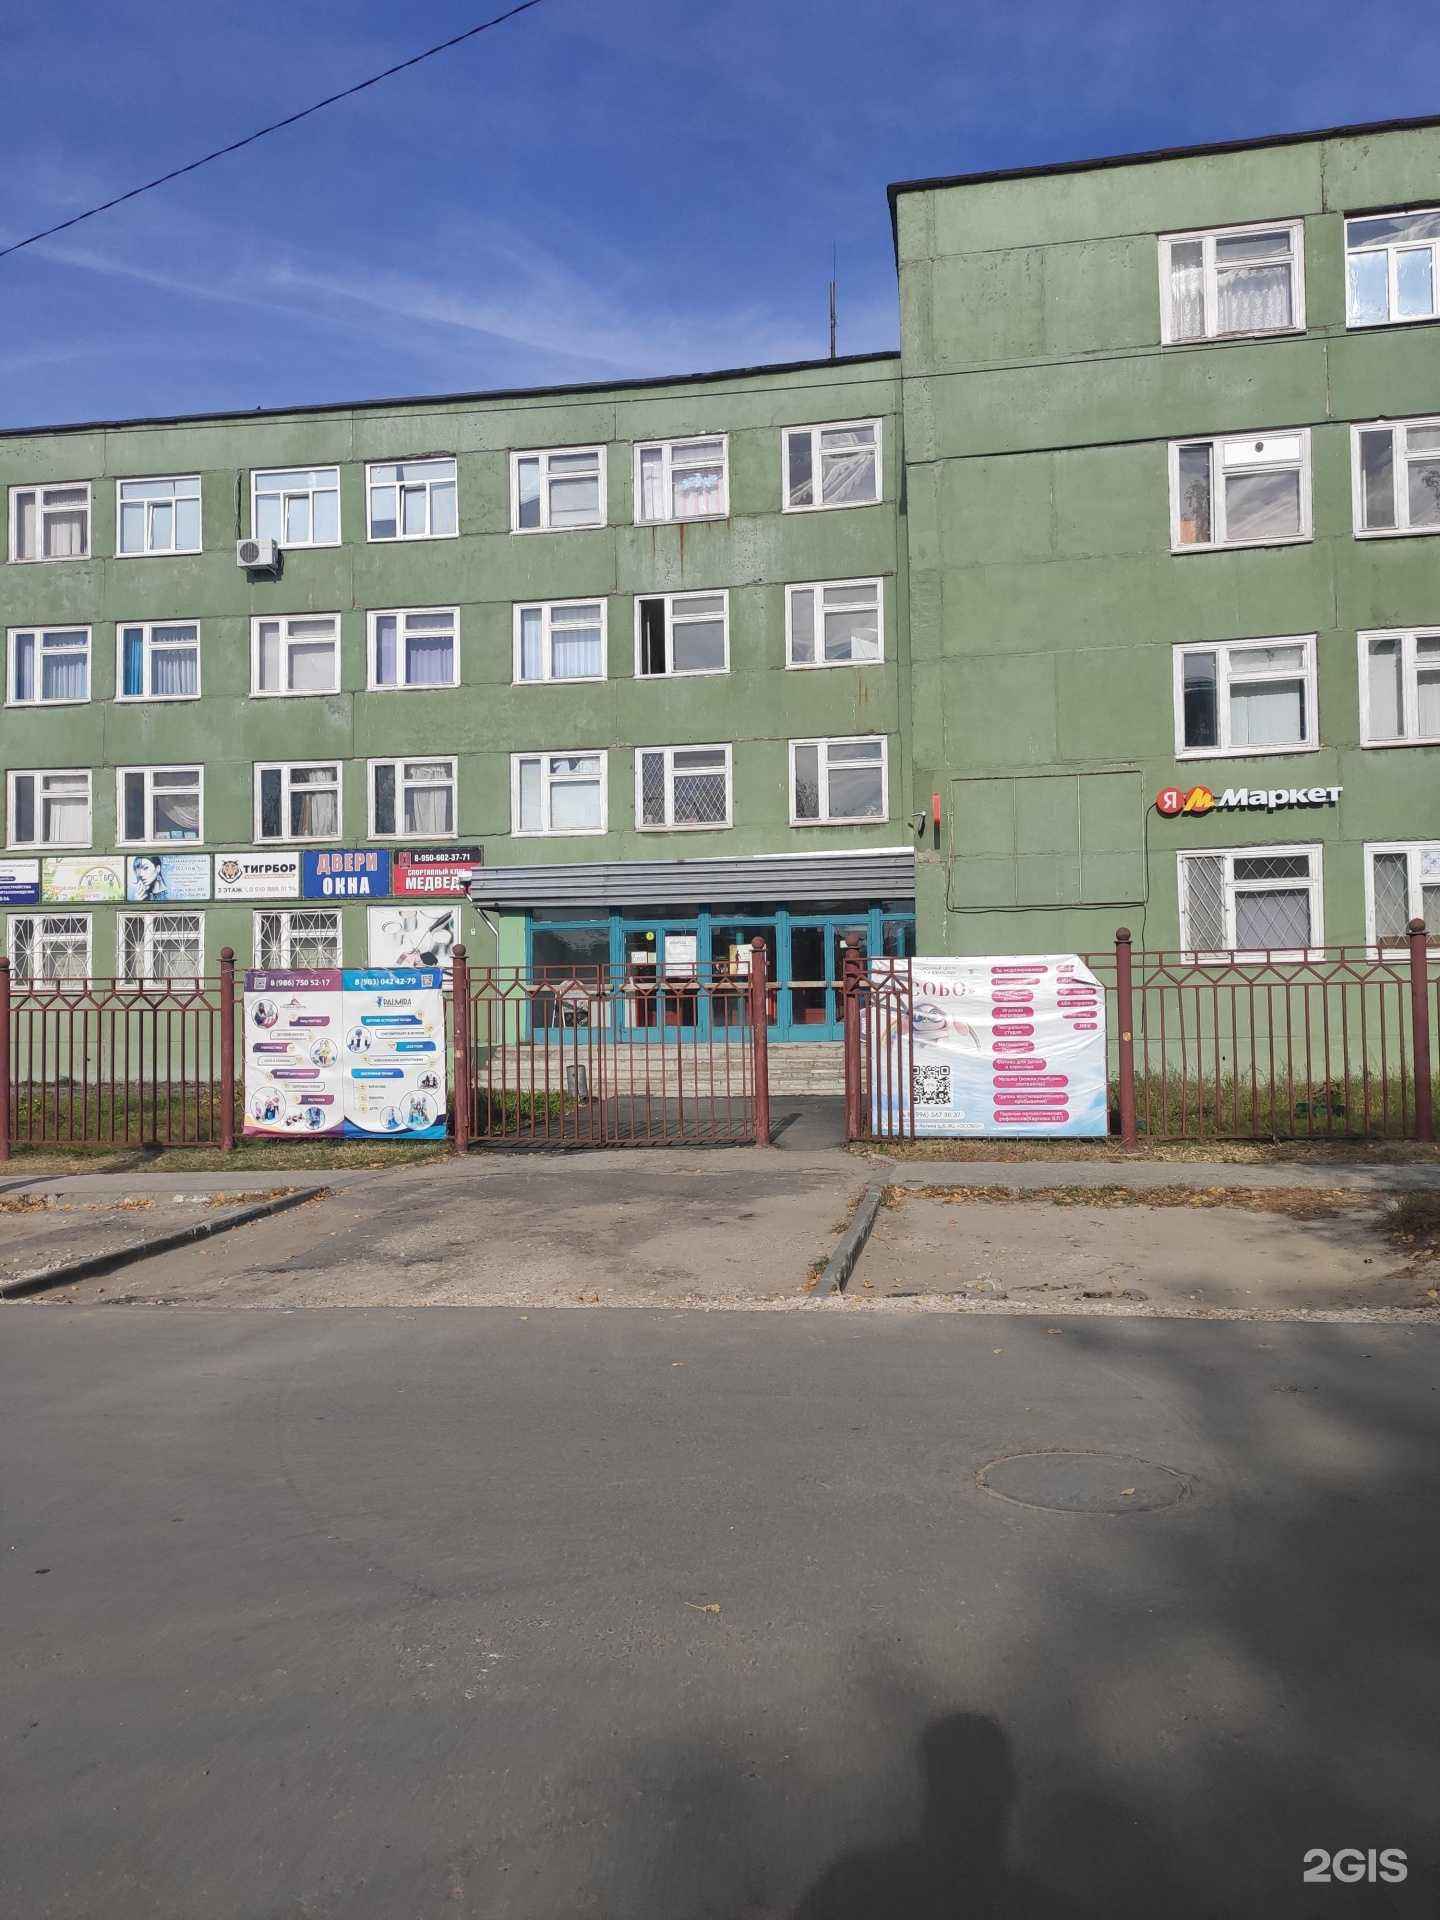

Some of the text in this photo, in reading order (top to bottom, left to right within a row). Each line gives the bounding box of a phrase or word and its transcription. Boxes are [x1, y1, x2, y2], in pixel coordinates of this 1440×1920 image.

[1217, 786, 1343, 807] Маркет
[316, 852, 378, 876] ДВЕРИ
[414, 853, 471, 862] 8-950-602-37-71
[243, 864, 296, 874] ТИГРБОР
[407, 867, 449, 876] СПОРТИВНЫЙ
[322, 876, 371, 895] ОКНА
[405, 876, 465, 892] МЕДВЕД
